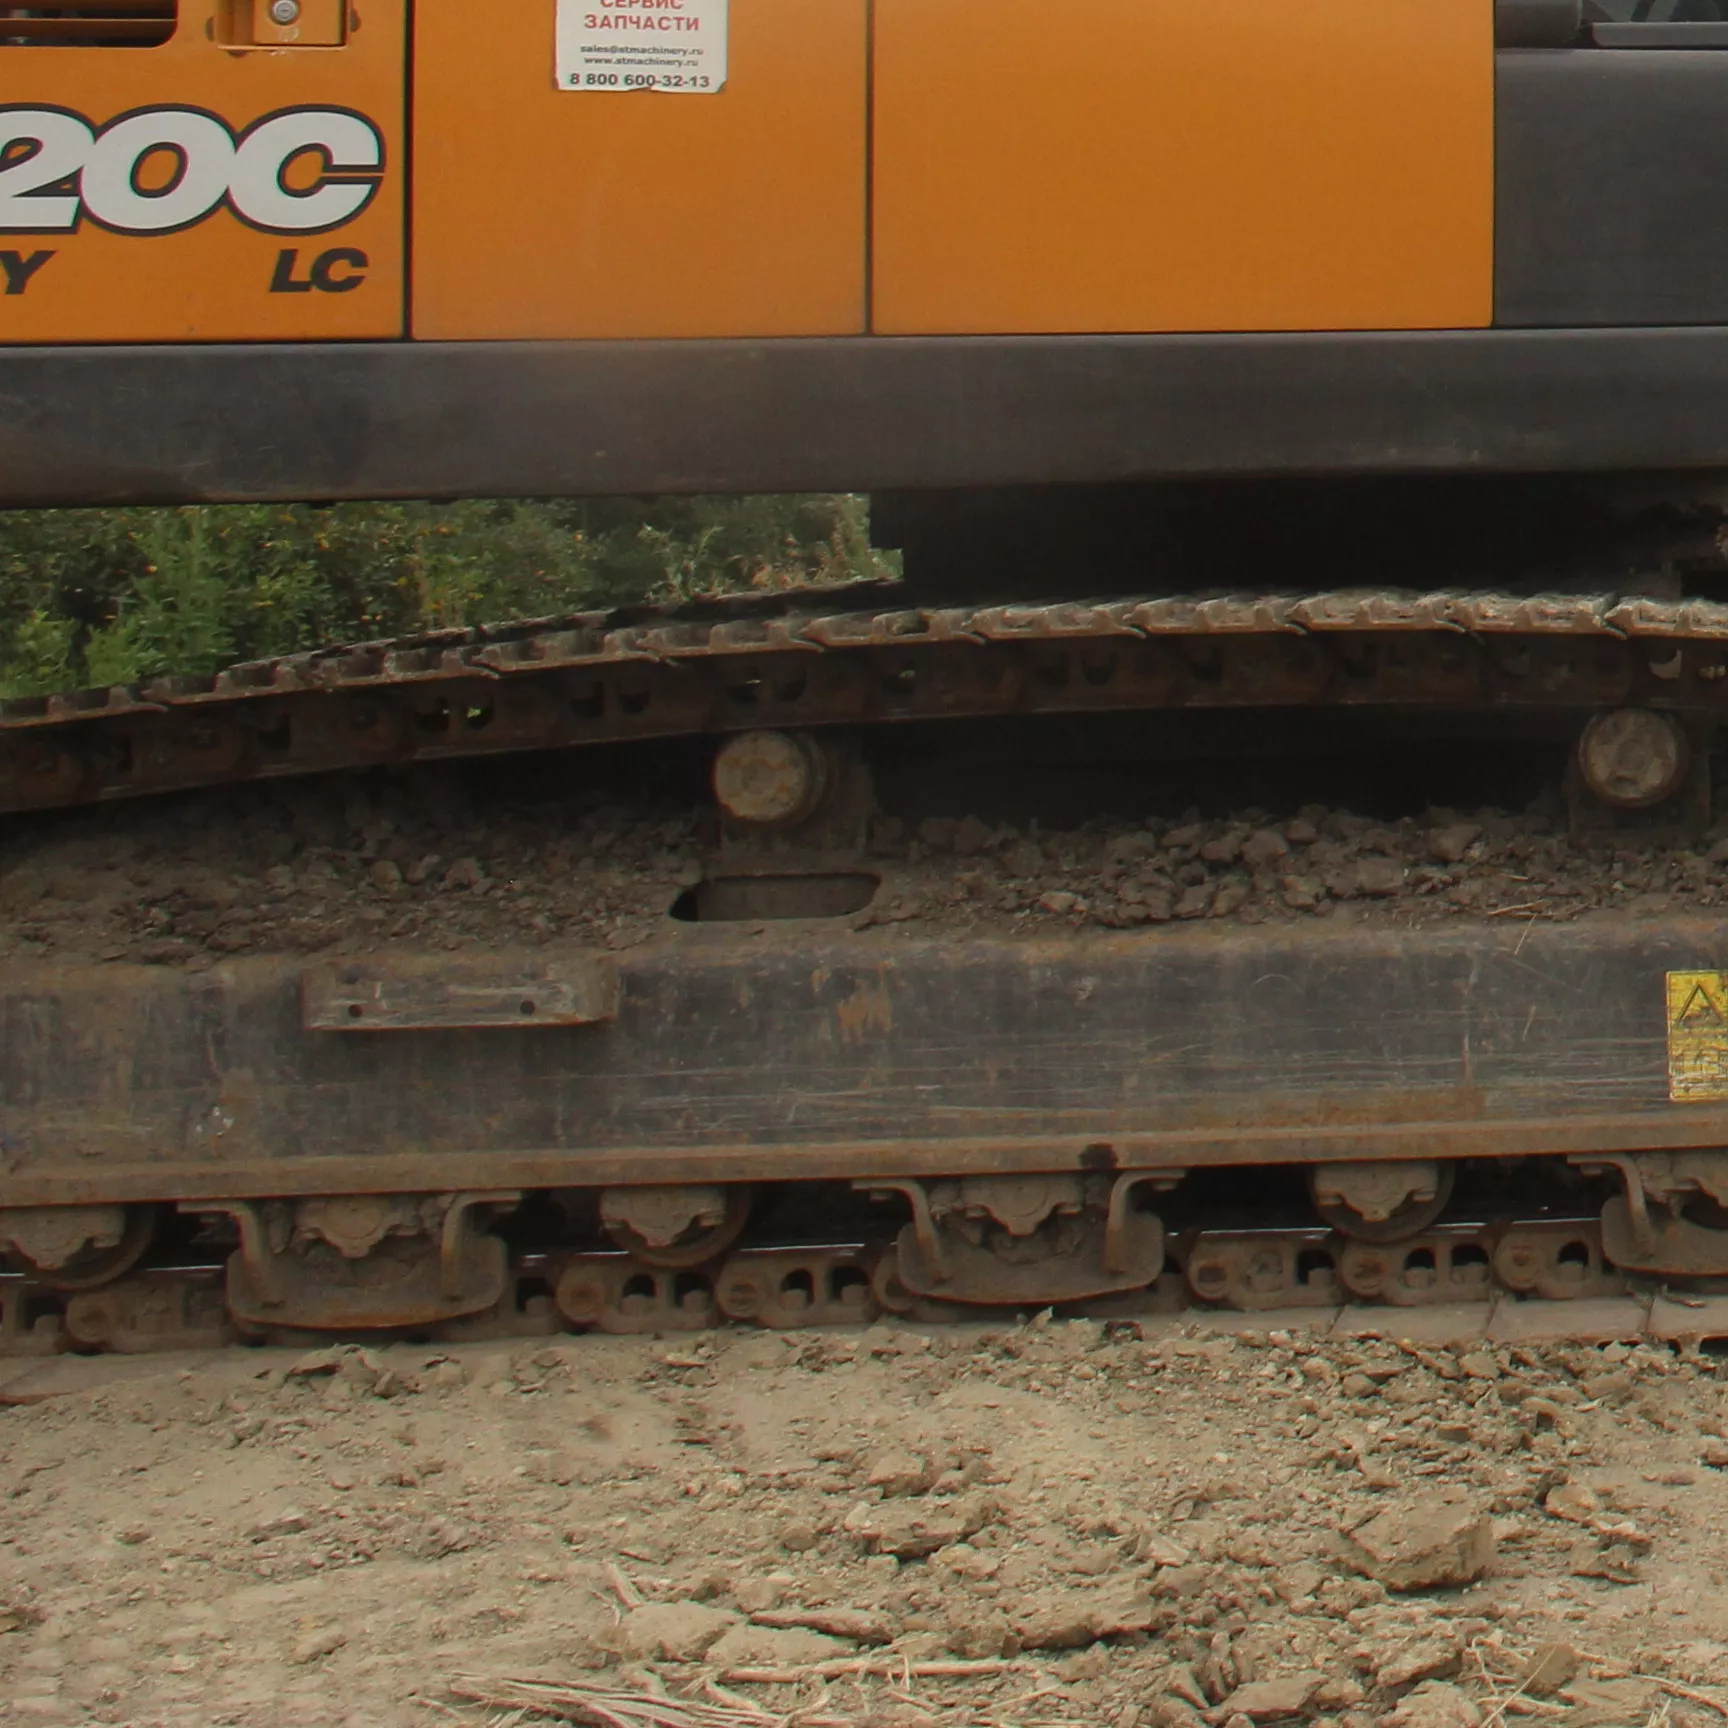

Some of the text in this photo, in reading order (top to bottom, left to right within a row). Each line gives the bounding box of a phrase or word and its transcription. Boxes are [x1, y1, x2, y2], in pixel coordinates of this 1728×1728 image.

[584, 14, 699, 31] ЗАПЧАСТИ
[580, 44, 704, 56] sales@stmachinery.ru
[584, 56, 699, 67] www.stmachinery.ru
[569, 72, 710, 88] 8 800 600-32-13
[268, 247, 369, 293] LC
